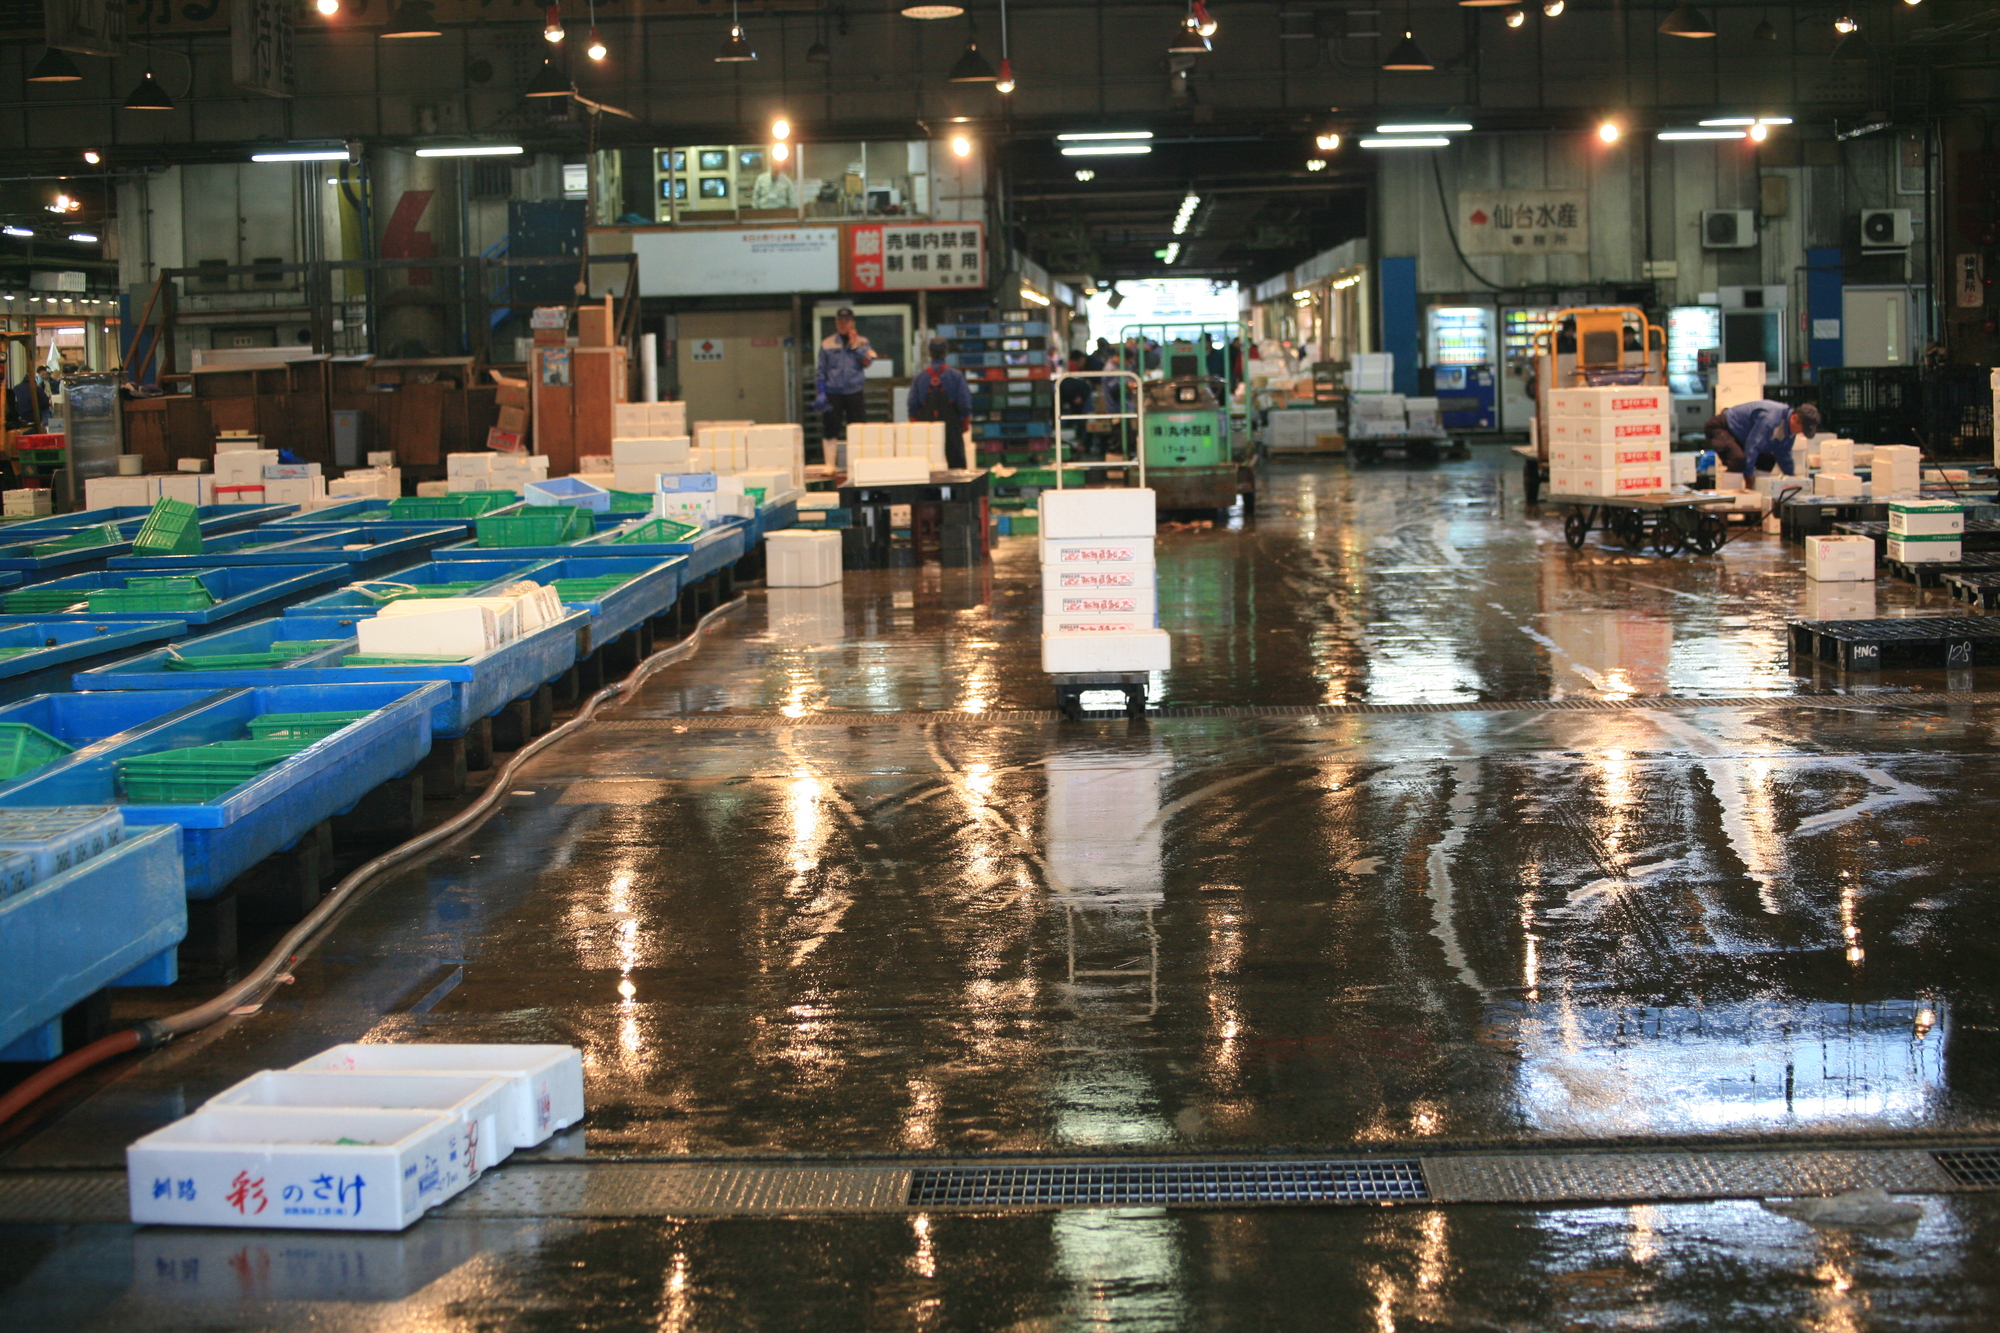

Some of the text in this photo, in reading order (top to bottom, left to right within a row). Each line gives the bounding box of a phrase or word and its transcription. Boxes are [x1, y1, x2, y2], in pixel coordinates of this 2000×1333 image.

[1493, 202, 1577, 229] 仙台水産
[887, 231, 977, 250] 売場内禁煙
[855, 229, 881, 288] 厳守
[887, 253, 977, 271] 制帽着用
[1854, 645, 1879, 660] HNC
[1947, 640, 1972, 666] 128
[152, 1176, 198, 1202] 釧路
[225, 1170, 367, 1217] 彩のさけ
